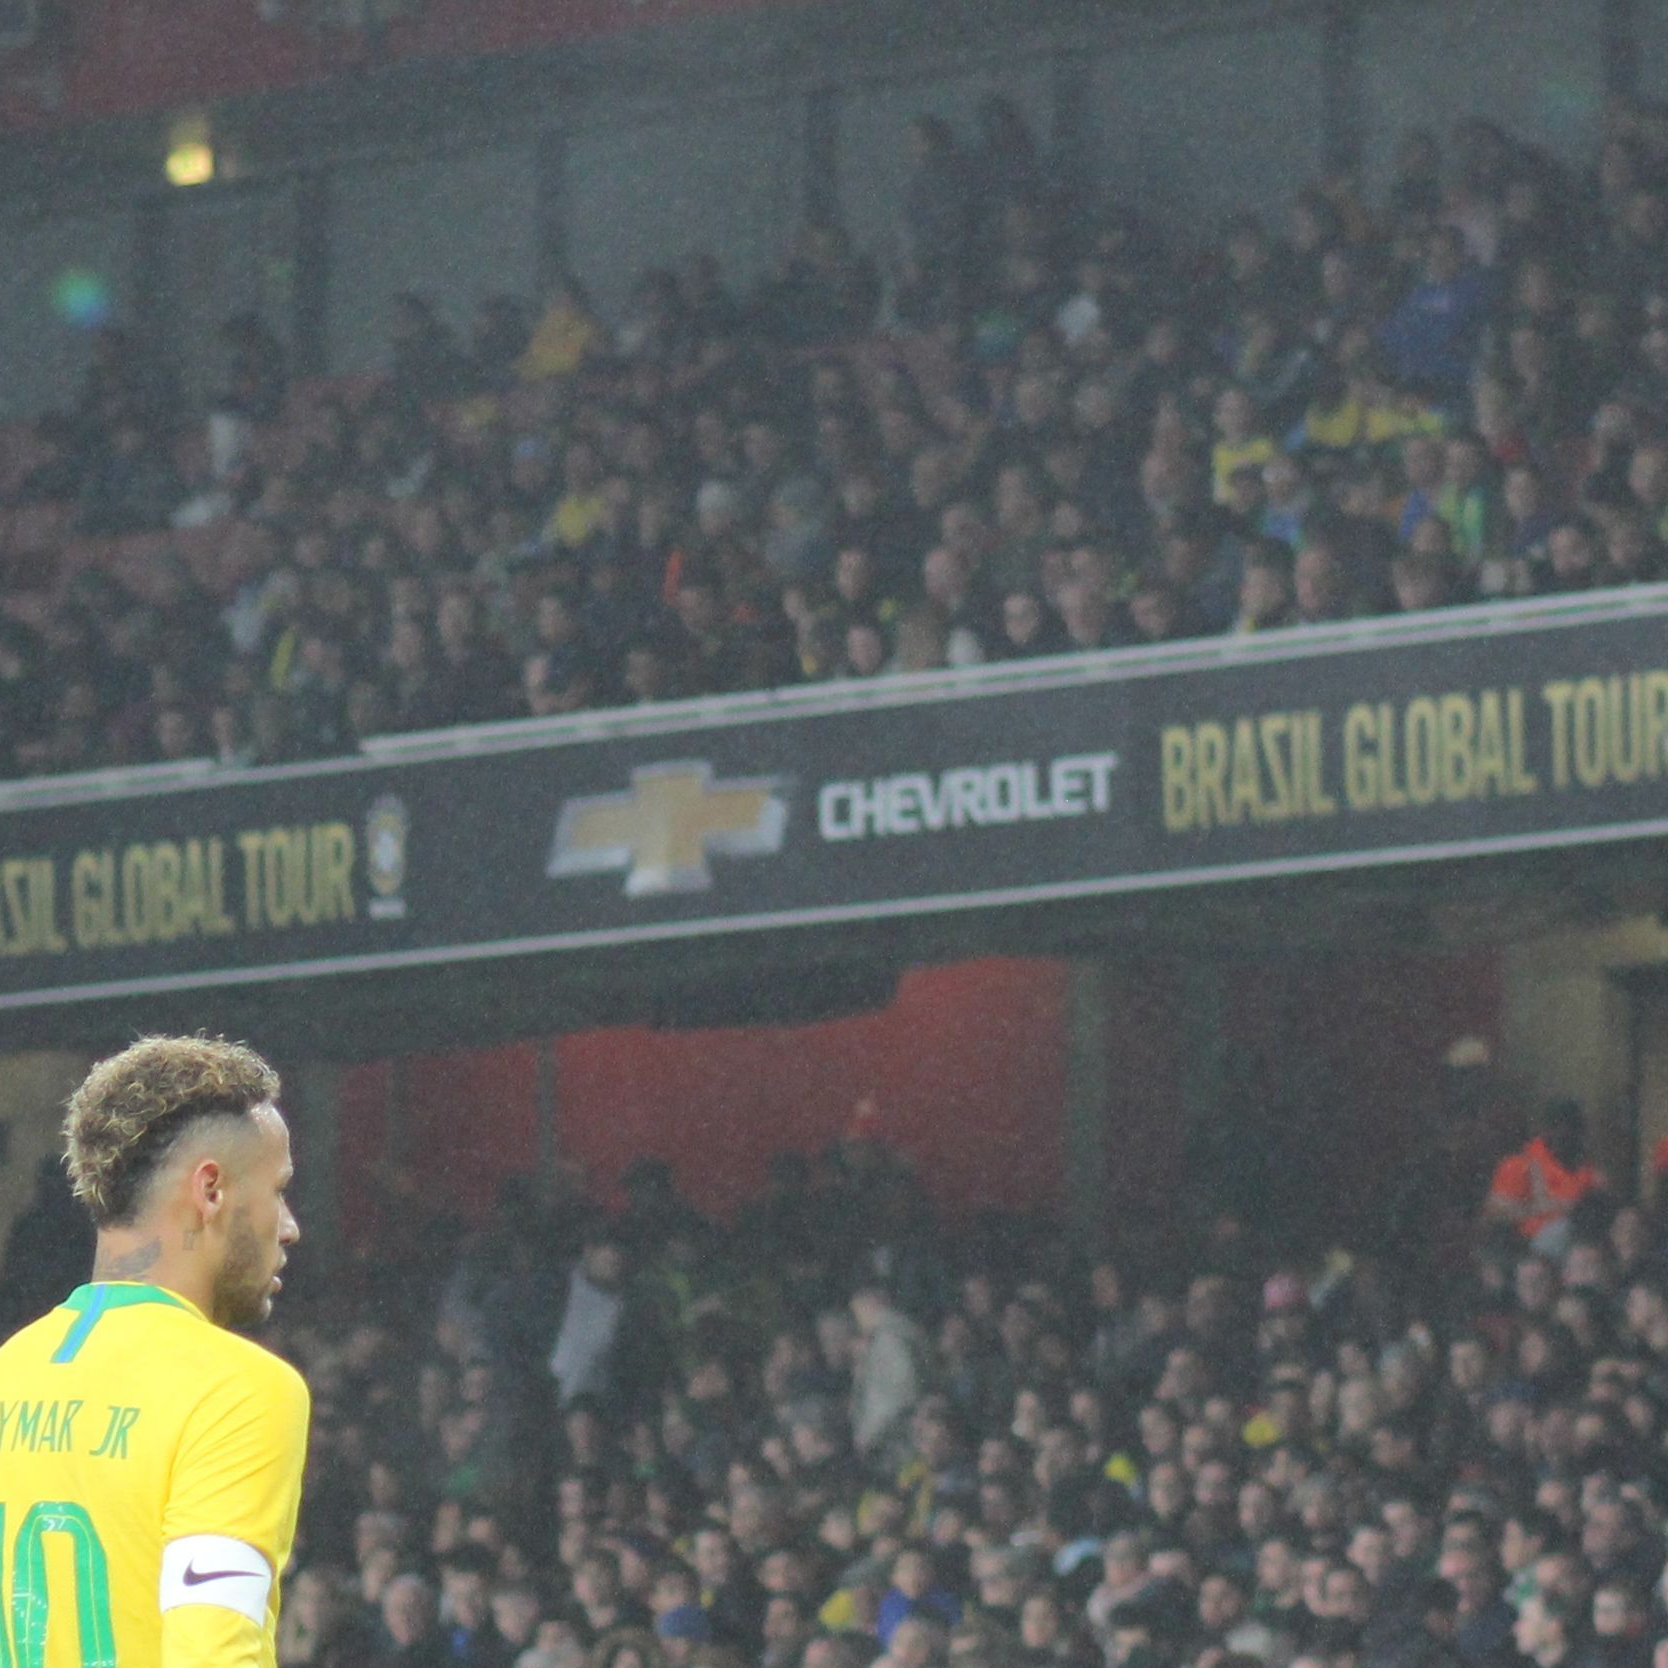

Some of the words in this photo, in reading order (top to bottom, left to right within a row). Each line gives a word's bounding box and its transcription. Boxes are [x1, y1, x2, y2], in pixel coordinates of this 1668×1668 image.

[819, 750, 1119, 842] CHEVROLET
[1161, 707, 1336, 834] BRASIL
[1343, 688, 1536, 811] GLOBAL
[72, 834, 236, 950] GLOBAL
[237, 820, 357, 931] TOUR
[88, 1404, 141, 1460] JR
